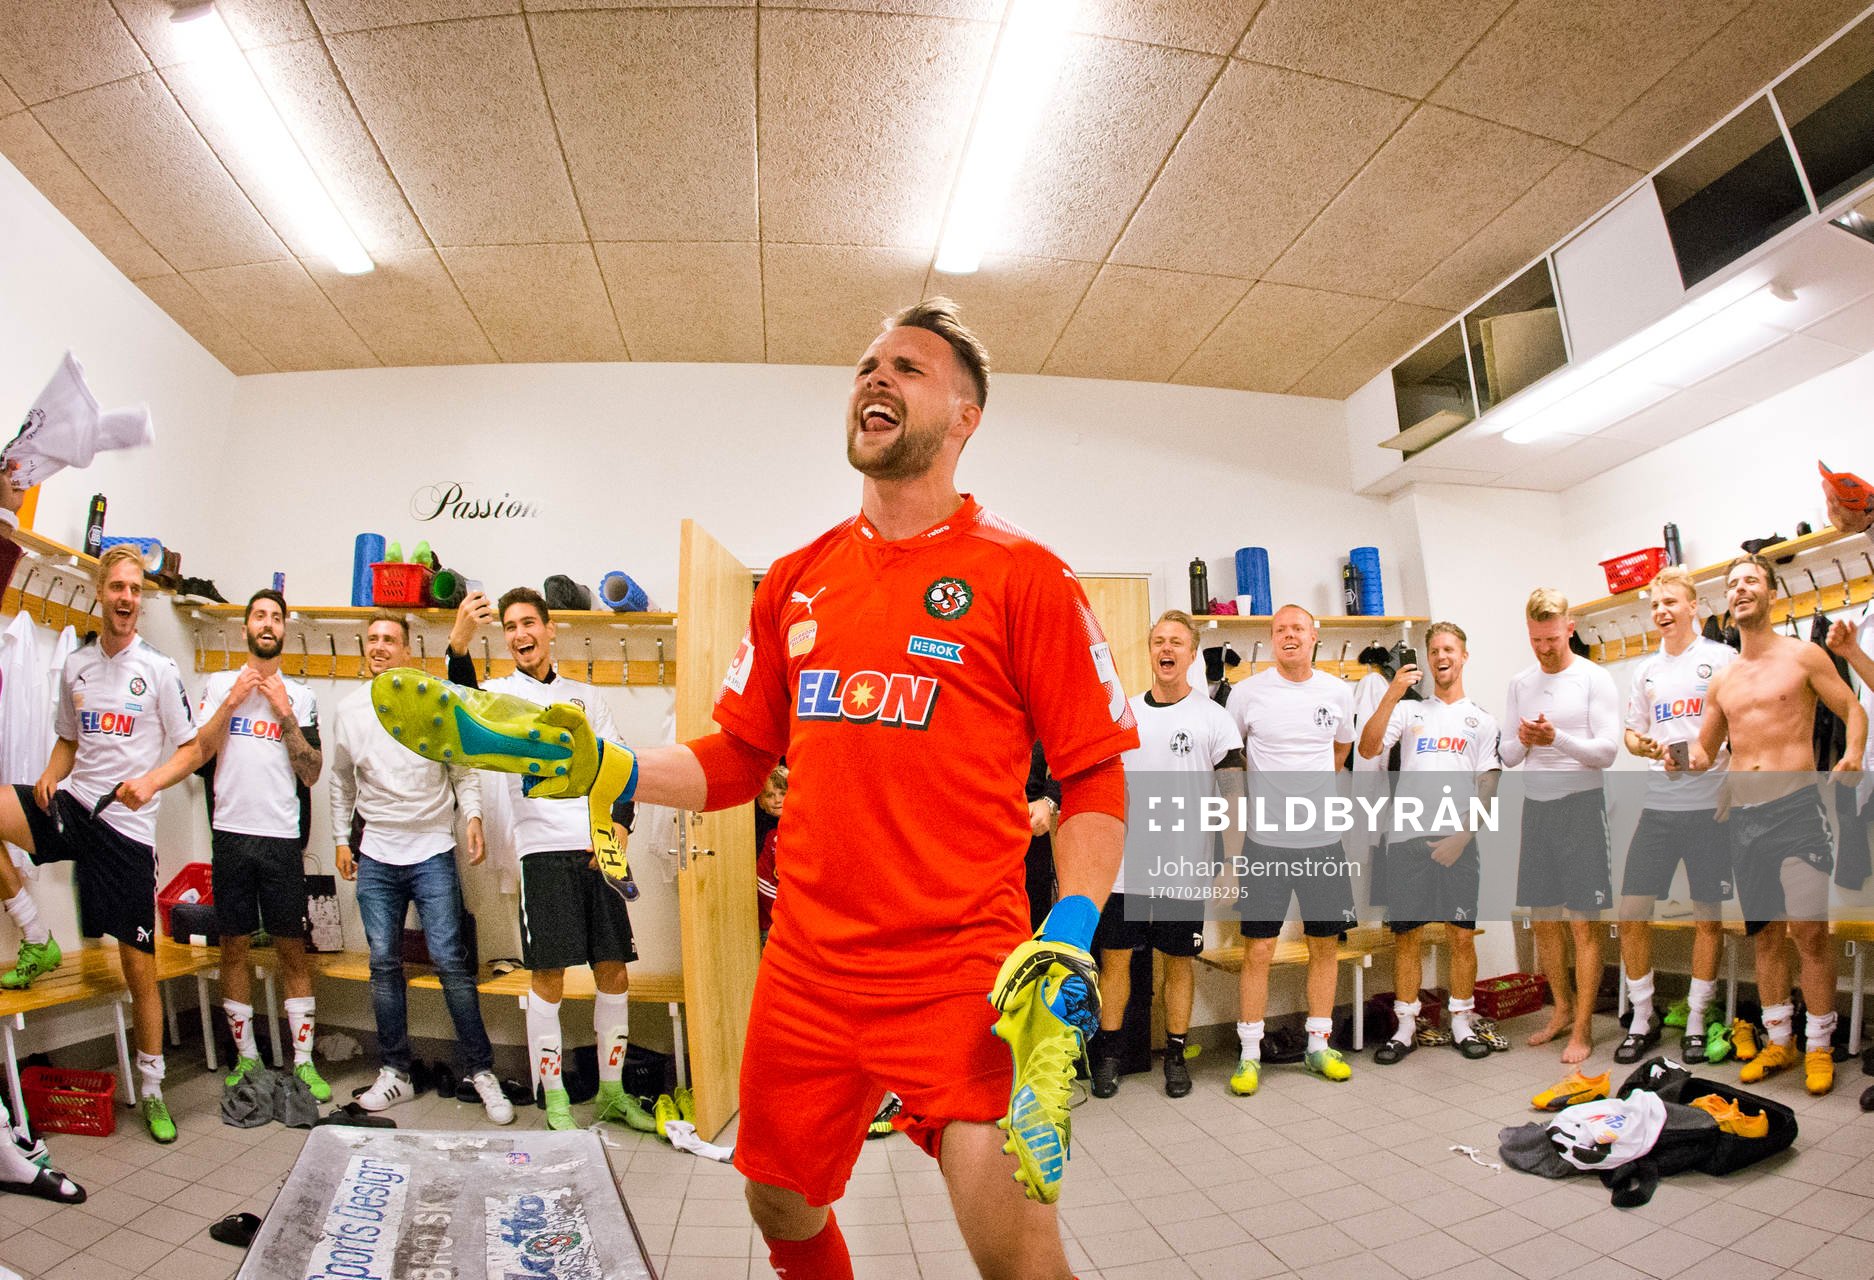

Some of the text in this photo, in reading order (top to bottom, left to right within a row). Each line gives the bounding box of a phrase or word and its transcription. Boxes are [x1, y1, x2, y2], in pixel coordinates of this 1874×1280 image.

[410, 481, 543, 521] Passion
[912, 640, 953, 658] HEROK
[797, 670, 940, 730] ELON
[1655, 698, 1703, 722] ELON
[81, 711, 135, 736] ELON
[230, 716, 283, 742] ELON
[1416, 737, 1467, 755] ELON
[333, 1159, 404, 1222] Design
